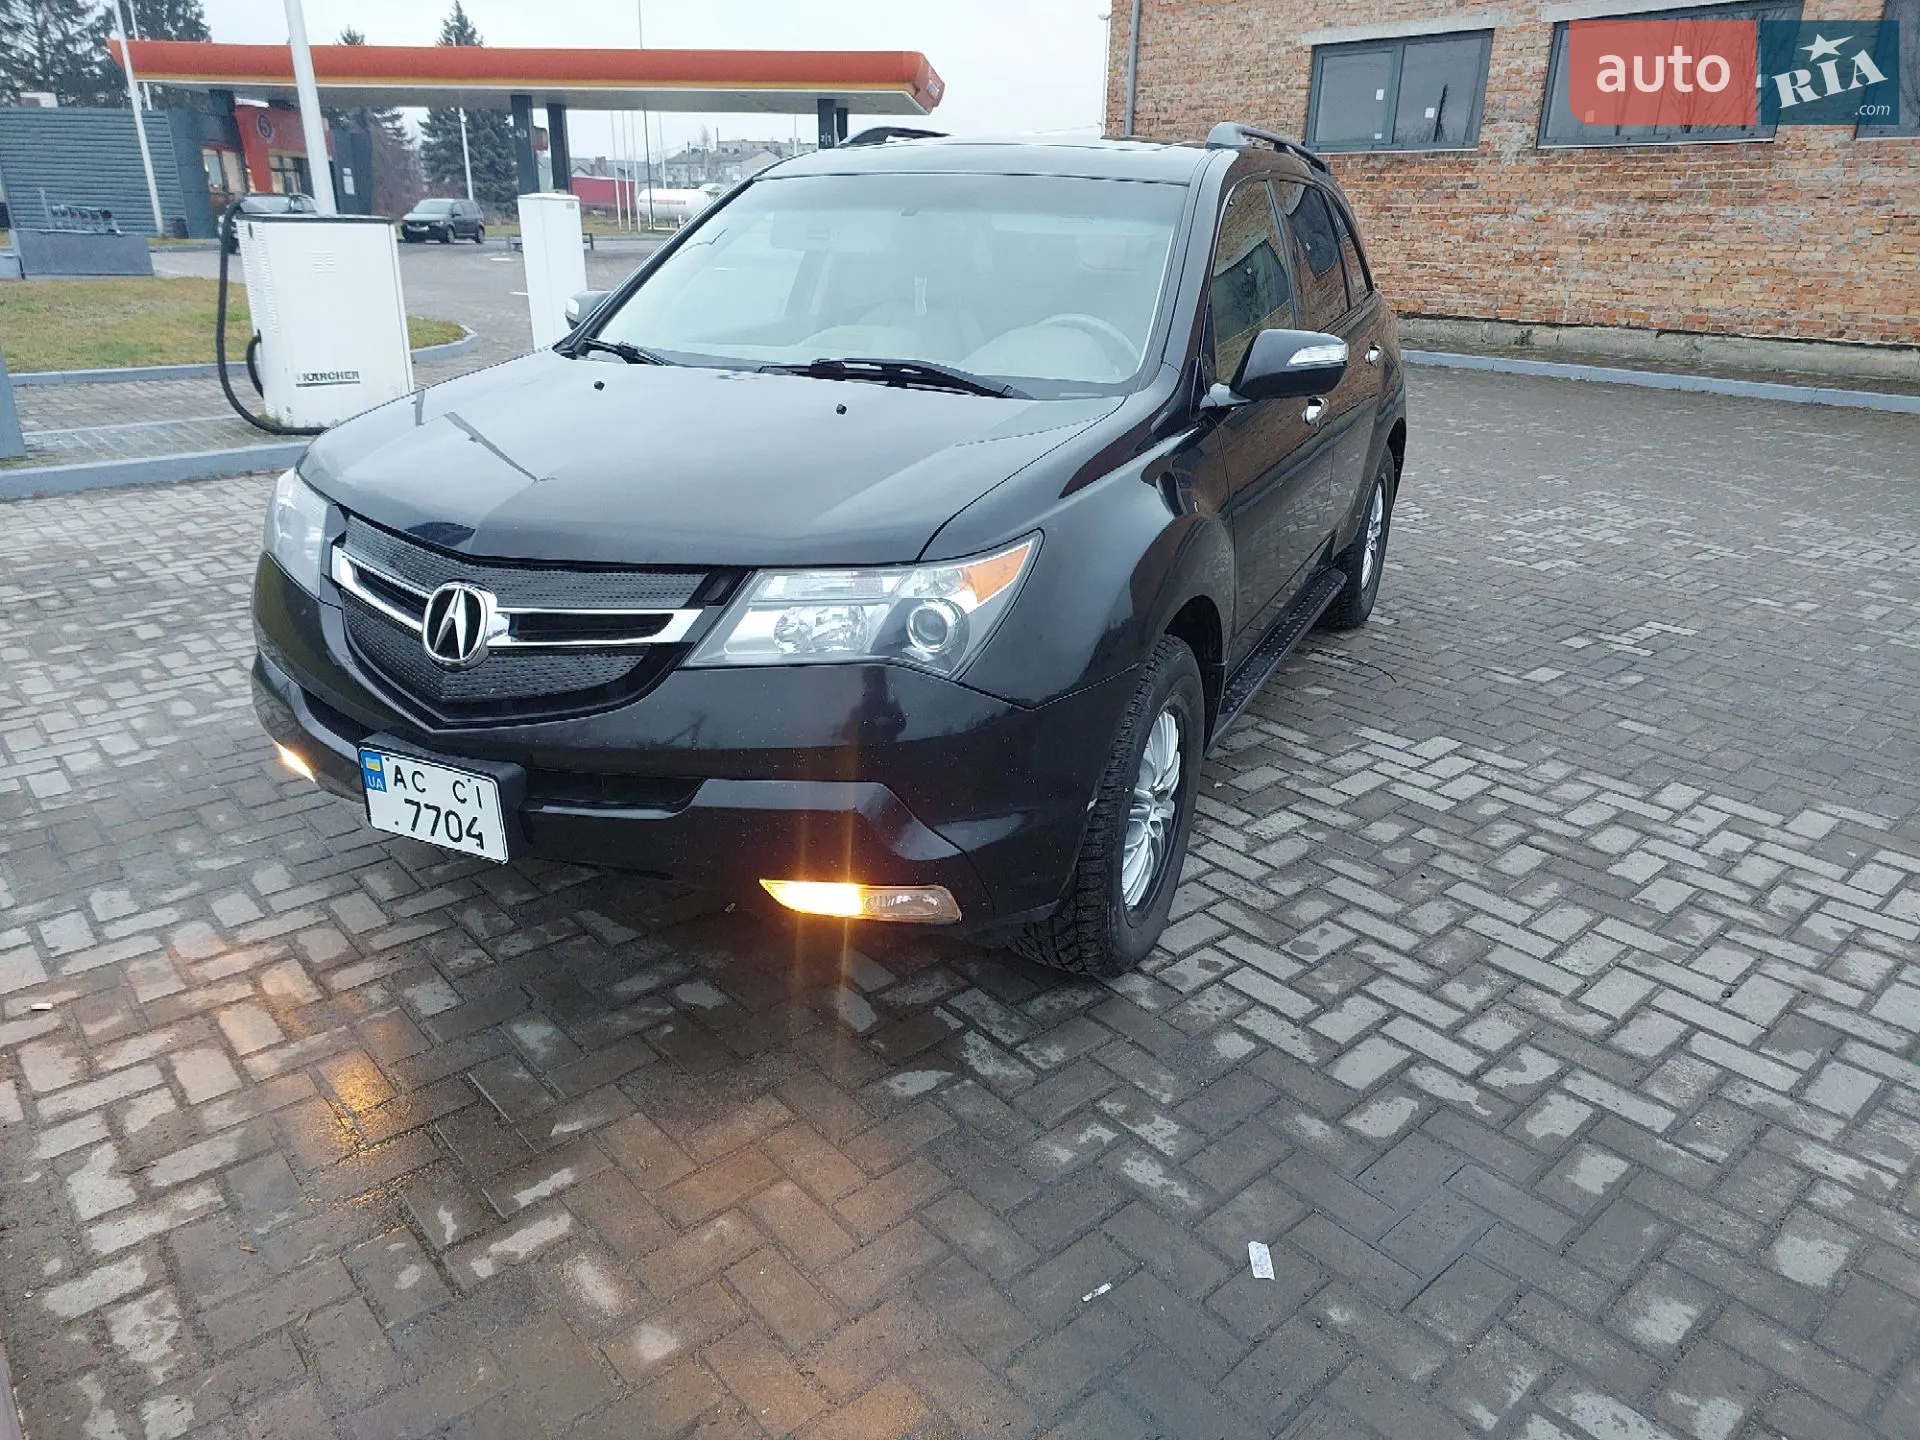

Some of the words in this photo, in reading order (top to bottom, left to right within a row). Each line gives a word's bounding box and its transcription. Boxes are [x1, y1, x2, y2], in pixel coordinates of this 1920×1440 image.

[367, 775, 384, 791] UA
[393, 765, 427, 793] AC
[404, 798, 484, 850] 7704
